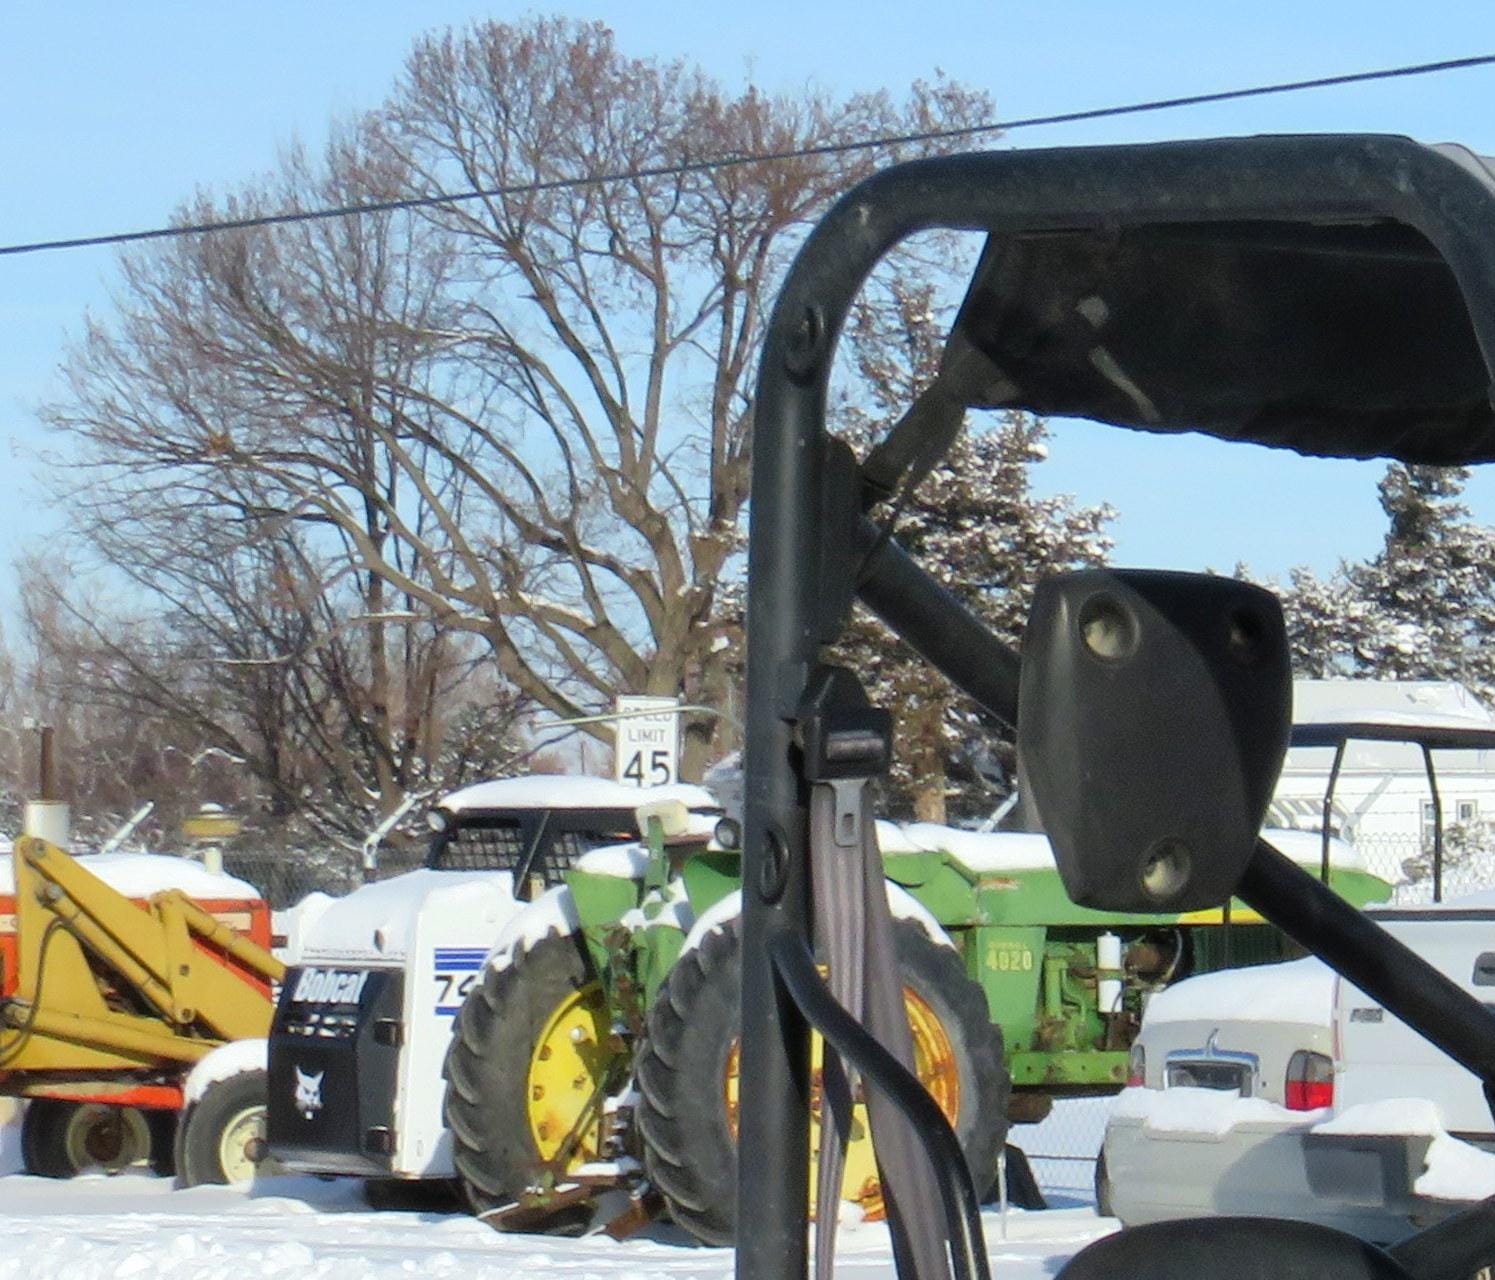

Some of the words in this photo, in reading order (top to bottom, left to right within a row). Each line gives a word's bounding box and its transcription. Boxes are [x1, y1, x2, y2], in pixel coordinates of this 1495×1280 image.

[627, 728, 666, 743] LIMIT
[623, 750, 671, 788] 45
[293, 966, 370, 1004] Bobcat
